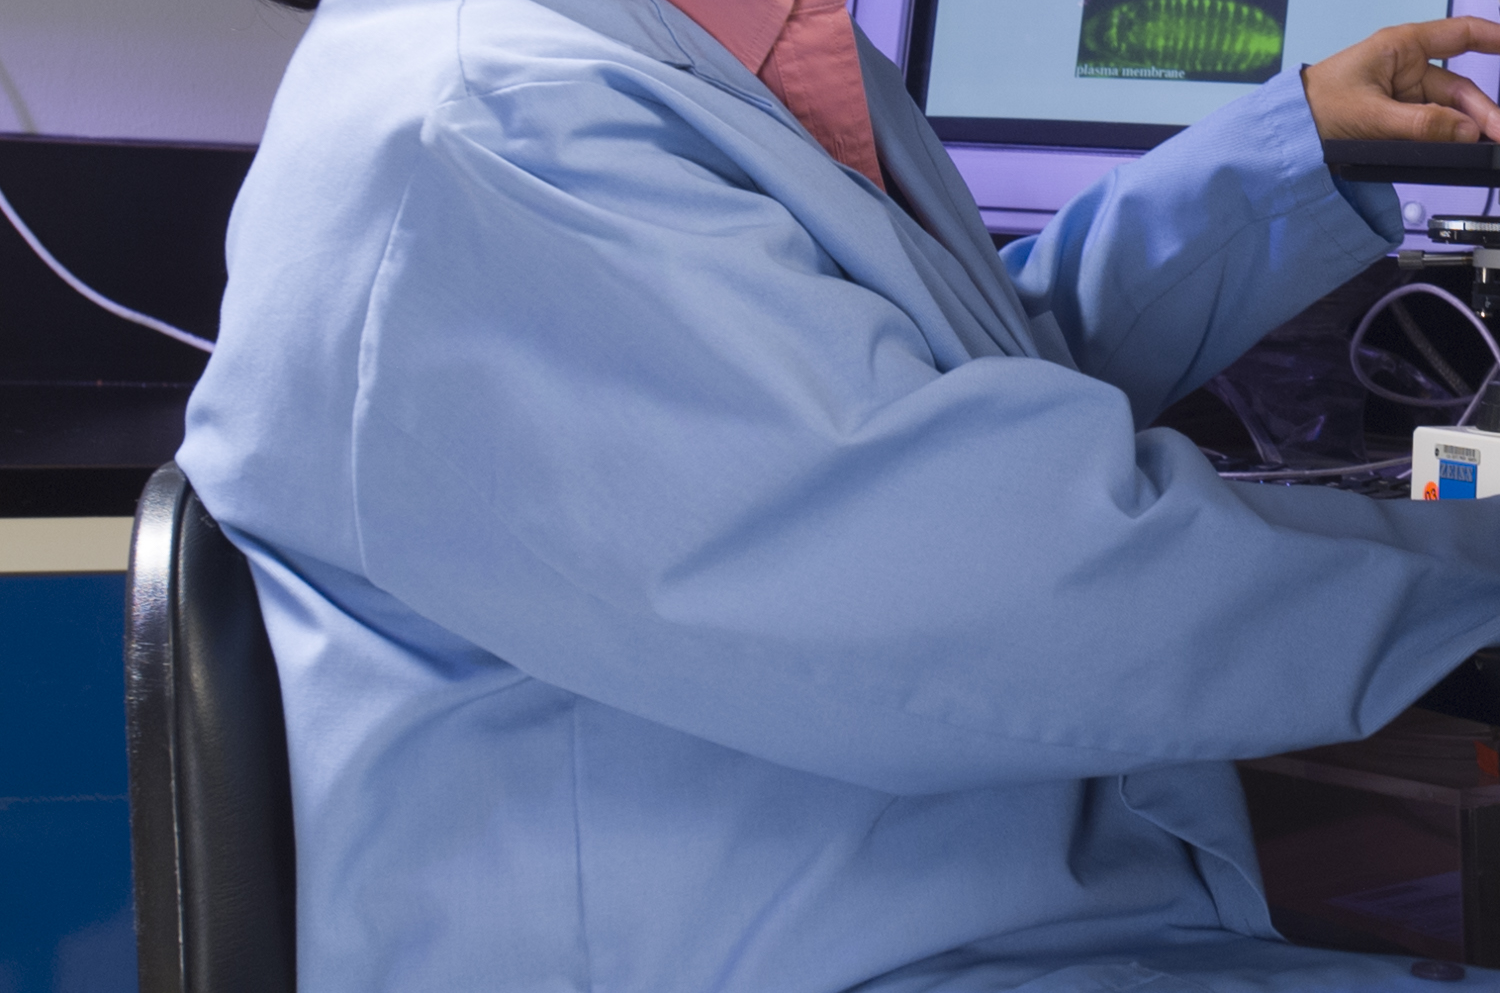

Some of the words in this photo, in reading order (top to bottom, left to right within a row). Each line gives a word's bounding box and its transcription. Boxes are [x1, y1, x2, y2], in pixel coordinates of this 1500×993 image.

[1076, 65, 1119, 78] plasma
[1122, 66, 1185, 79] membrane
[1440, 463, 1474, 483] ZEISS
